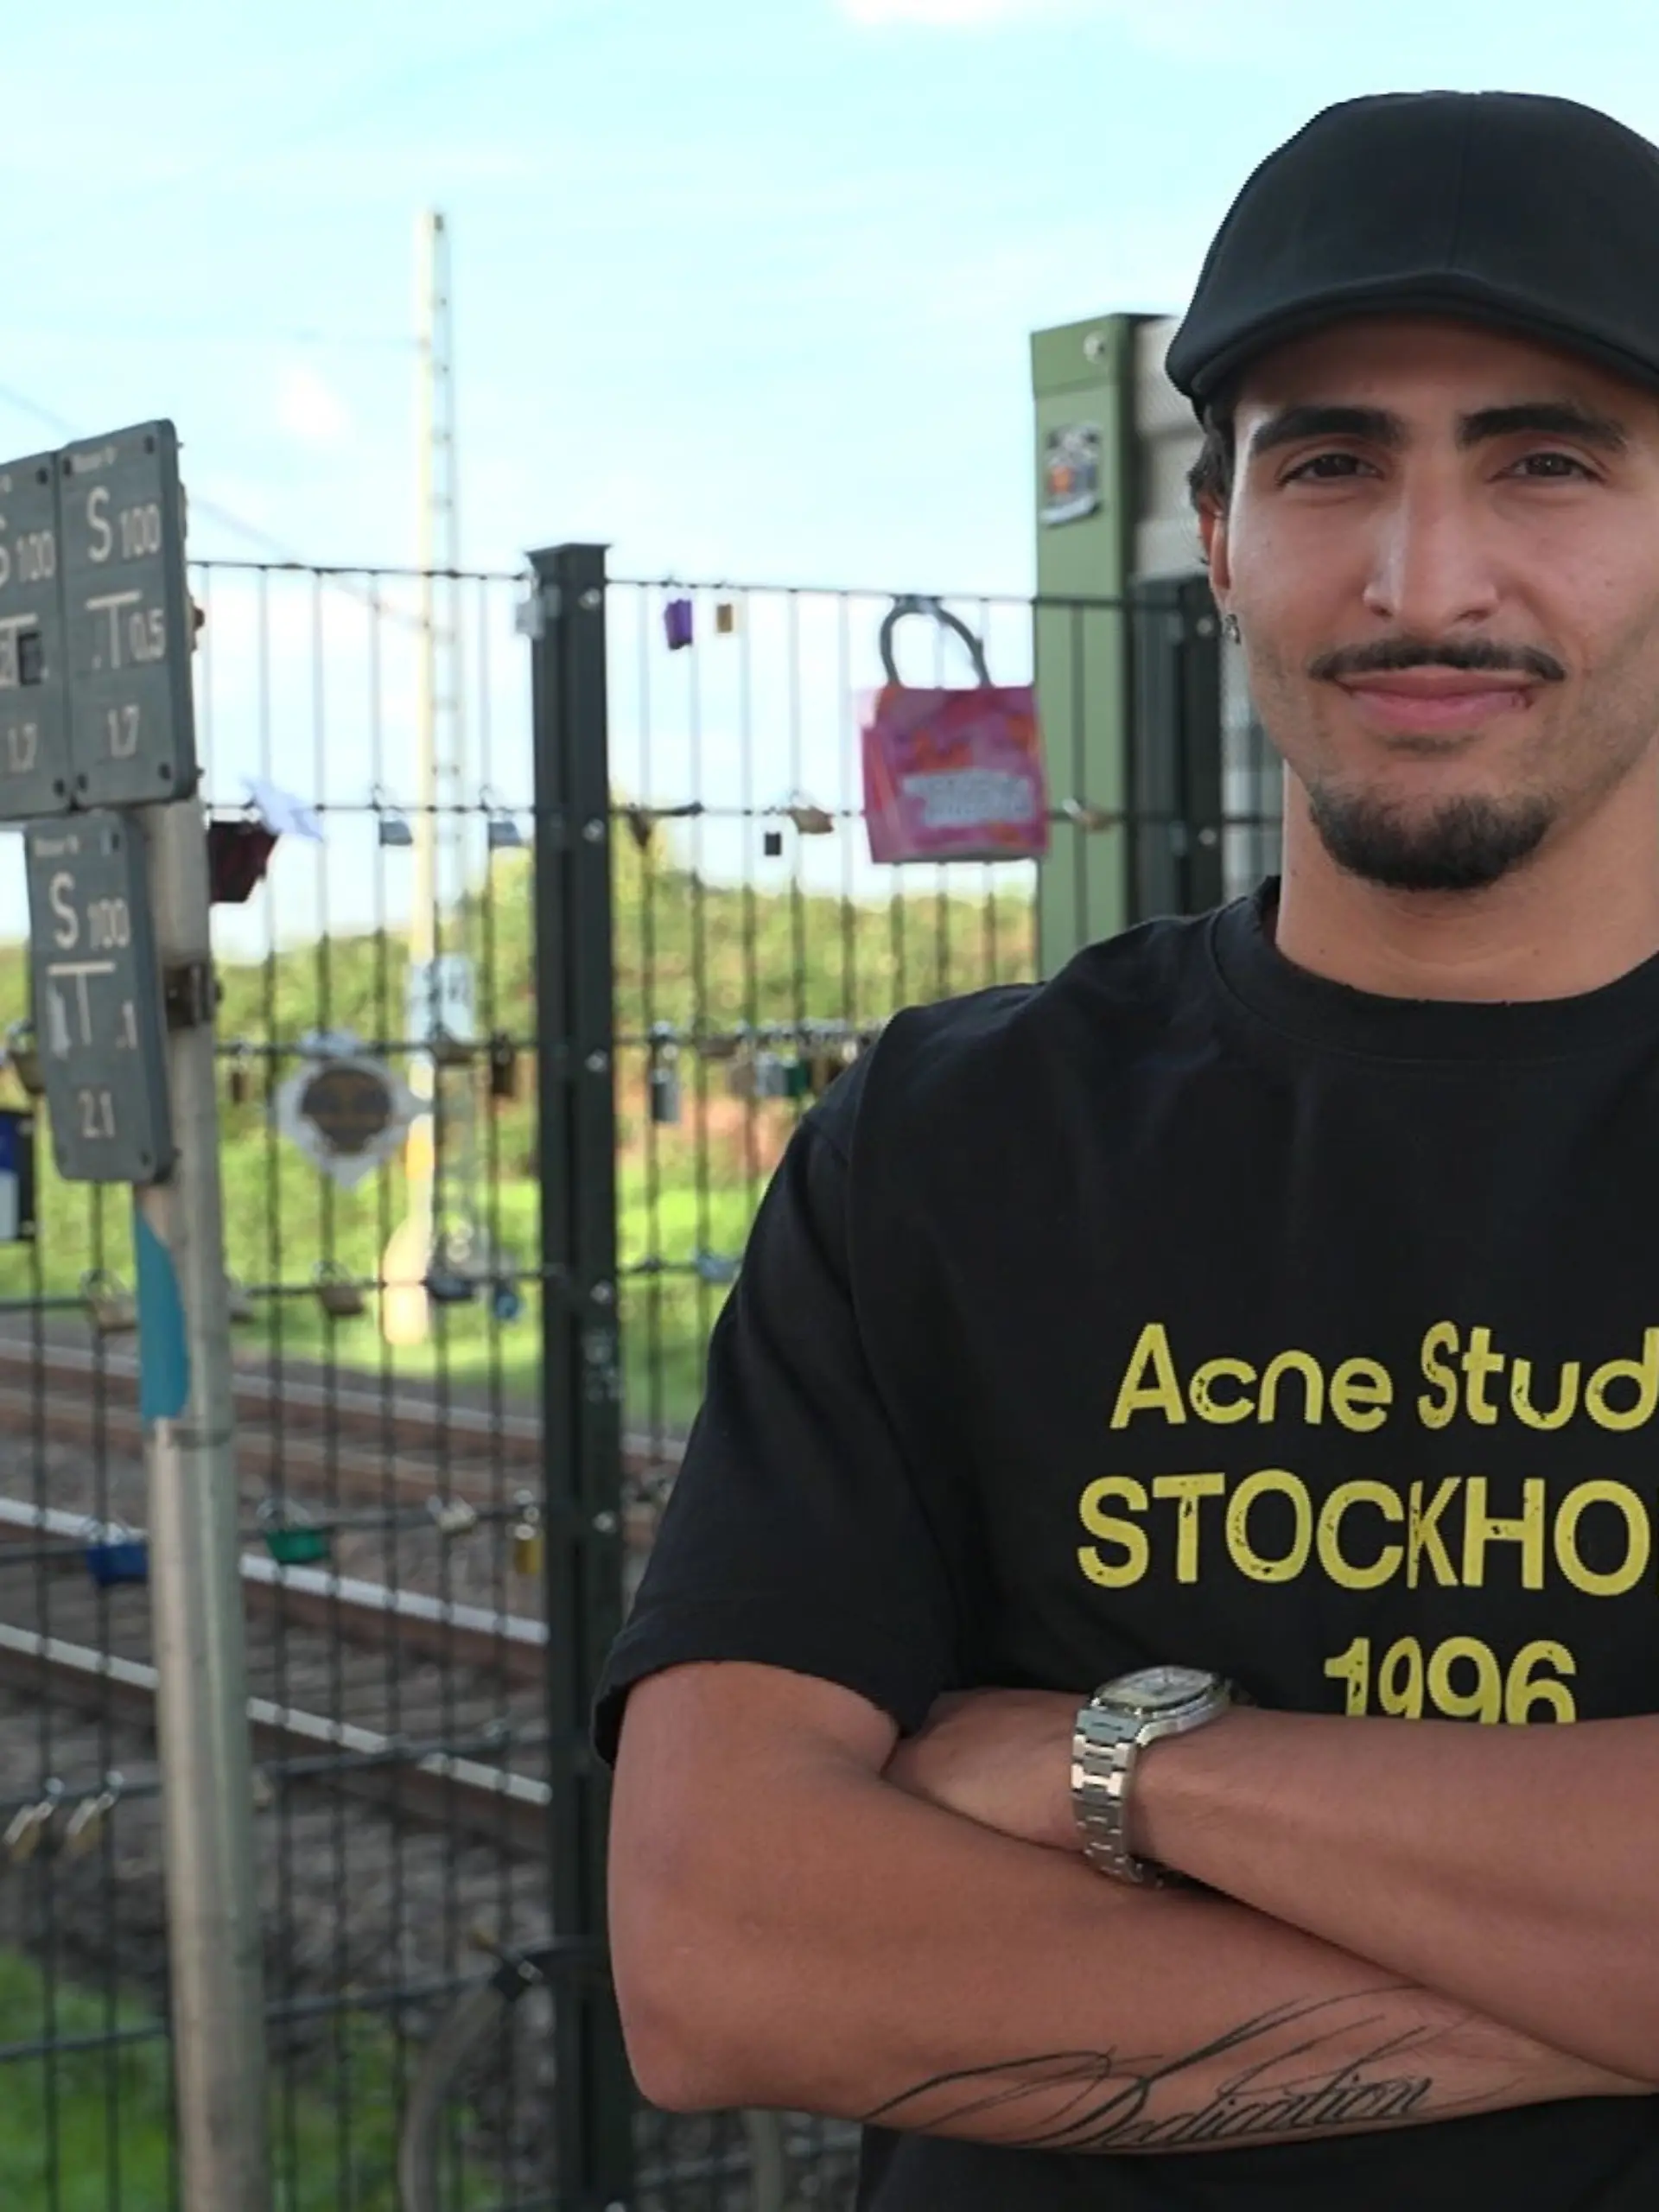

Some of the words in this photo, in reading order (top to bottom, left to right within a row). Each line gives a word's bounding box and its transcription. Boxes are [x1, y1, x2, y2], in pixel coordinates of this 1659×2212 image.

[87, 486, 112, 563] S
[119, 503, 163, 560] 100
[49, 871, 79, 950] S
[1109, 1321, 1395, 1433] Acne
[1416, 1319, 1659, 1432] Stud
[1076, 1468, 1651, 1597] STOCKHO
[1323, 1636, 1578, 1725] 1996
